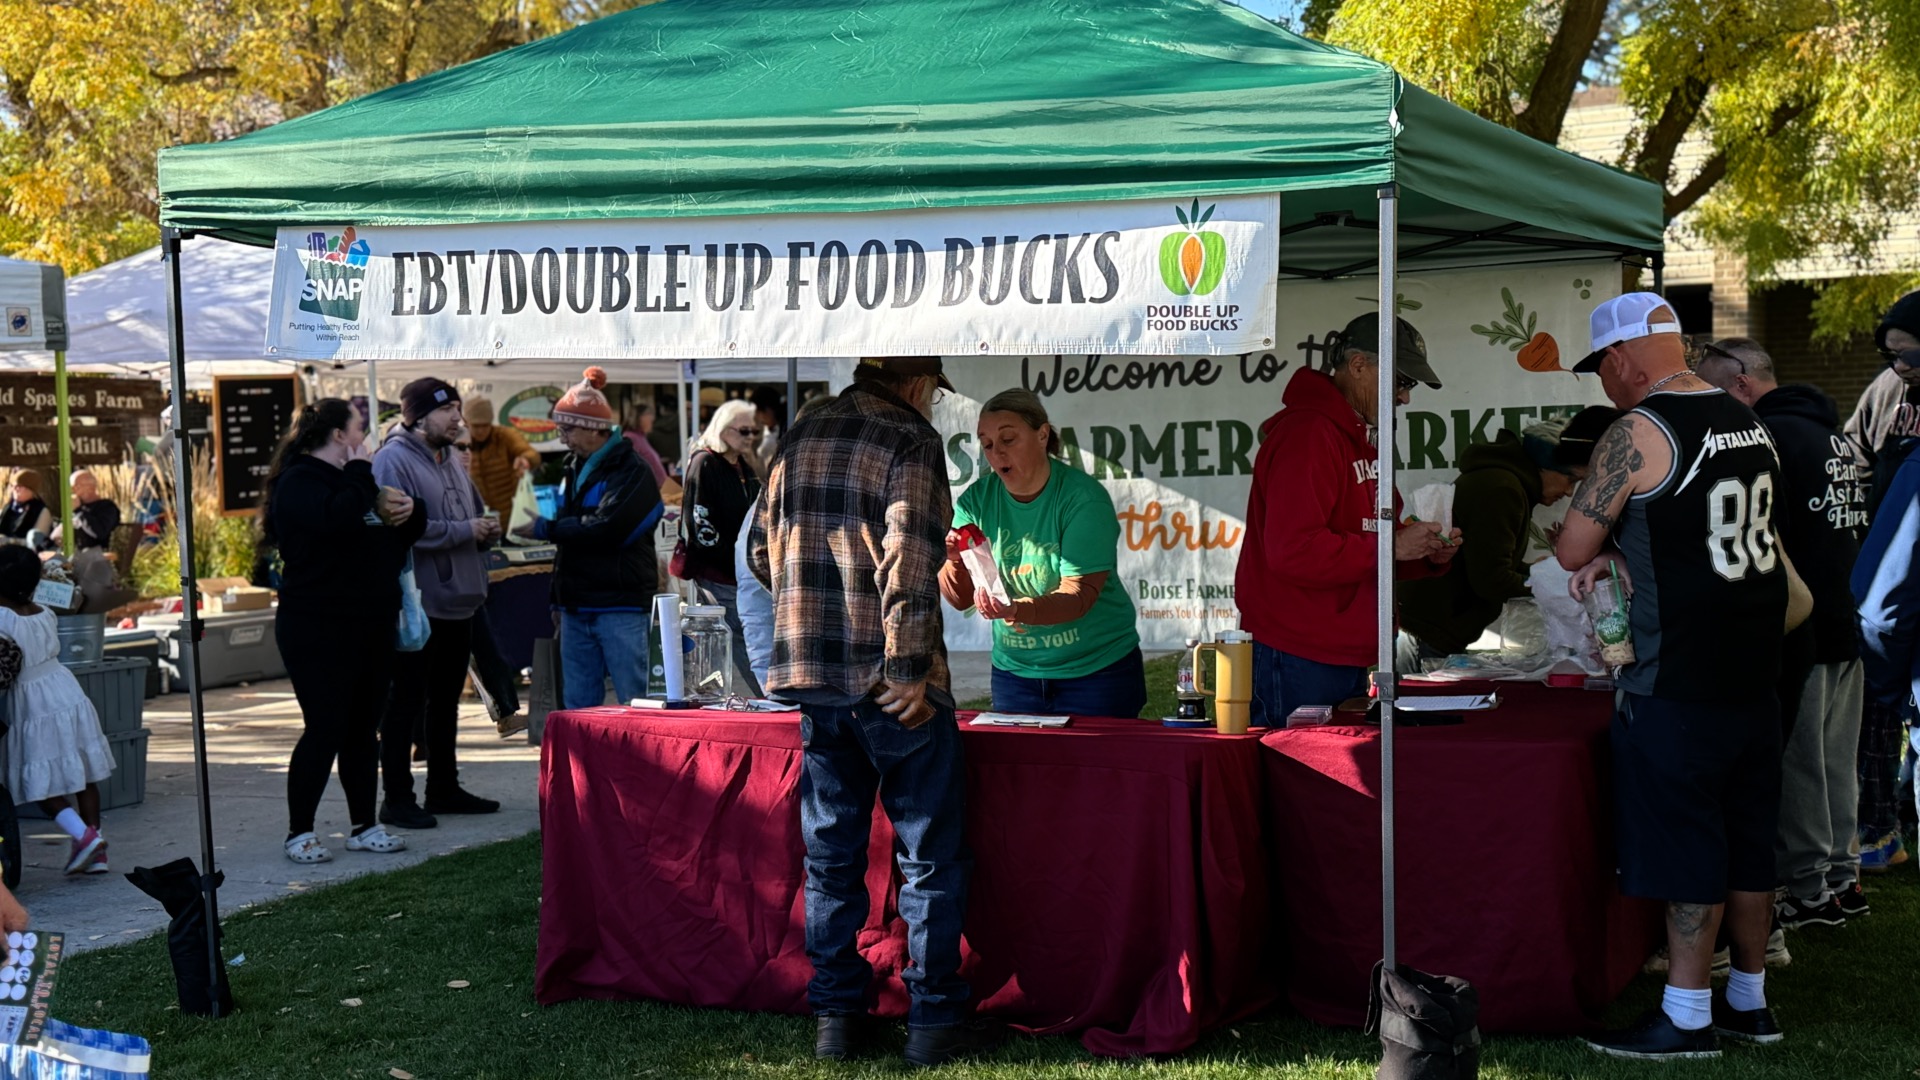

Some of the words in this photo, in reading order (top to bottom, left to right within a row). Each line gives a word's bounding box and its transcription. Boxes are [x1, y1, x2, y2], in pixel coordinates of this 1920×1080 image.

[391, 245, 691, 316] EBT/DOUBLE
[704, 243, 773, 312] UP
[785, 239, 927, 311] FOOD
[938, 231, 1121, 307] BUCKS
[301, 278, 364, 302] SNAP
[1146, 305, 1212, 318] DOUBLE
[1216, 305, 1240, 318] UP
[289, 322, 315, 332] Putting
[317, 322, 341, 332] Healthy
[342, 322, 360, 331] Food
[1146, 319, 1187, 331] FOOD
[1190, 319, 1239, 331] BUCKS
[1020, 355, 1223, 397] Welcome
[1234, 352, 1288, 384] to
[1296, 330, 1341, 376] th
[24, 387, 87, 411] Spaes
[95, 389, 144, 410] Farm
[556, 414, 608, 430] IDAHO
[11, 437, 52, 456] Raw
[1056, 419, 1266, 482] ARMER
[1116, 500, 1242, 552] thru
[1706, 471, 1777, 582] 88
[1139, 579, 1183, 600] BOISE
[1186, 578, 1236, 600] FARME
[1139, 605, 1174, 620] Farmers
[1175, 605, 1192, 620] You
[1193, 605, 1209, 620] Can
[1002, 632, 1037, 650] HELP
[1041, 627, 1080, 648] YOU!
[43, 935, 62, 978] LOYAL
[25, 1002, 49, 1041] LOCAL
